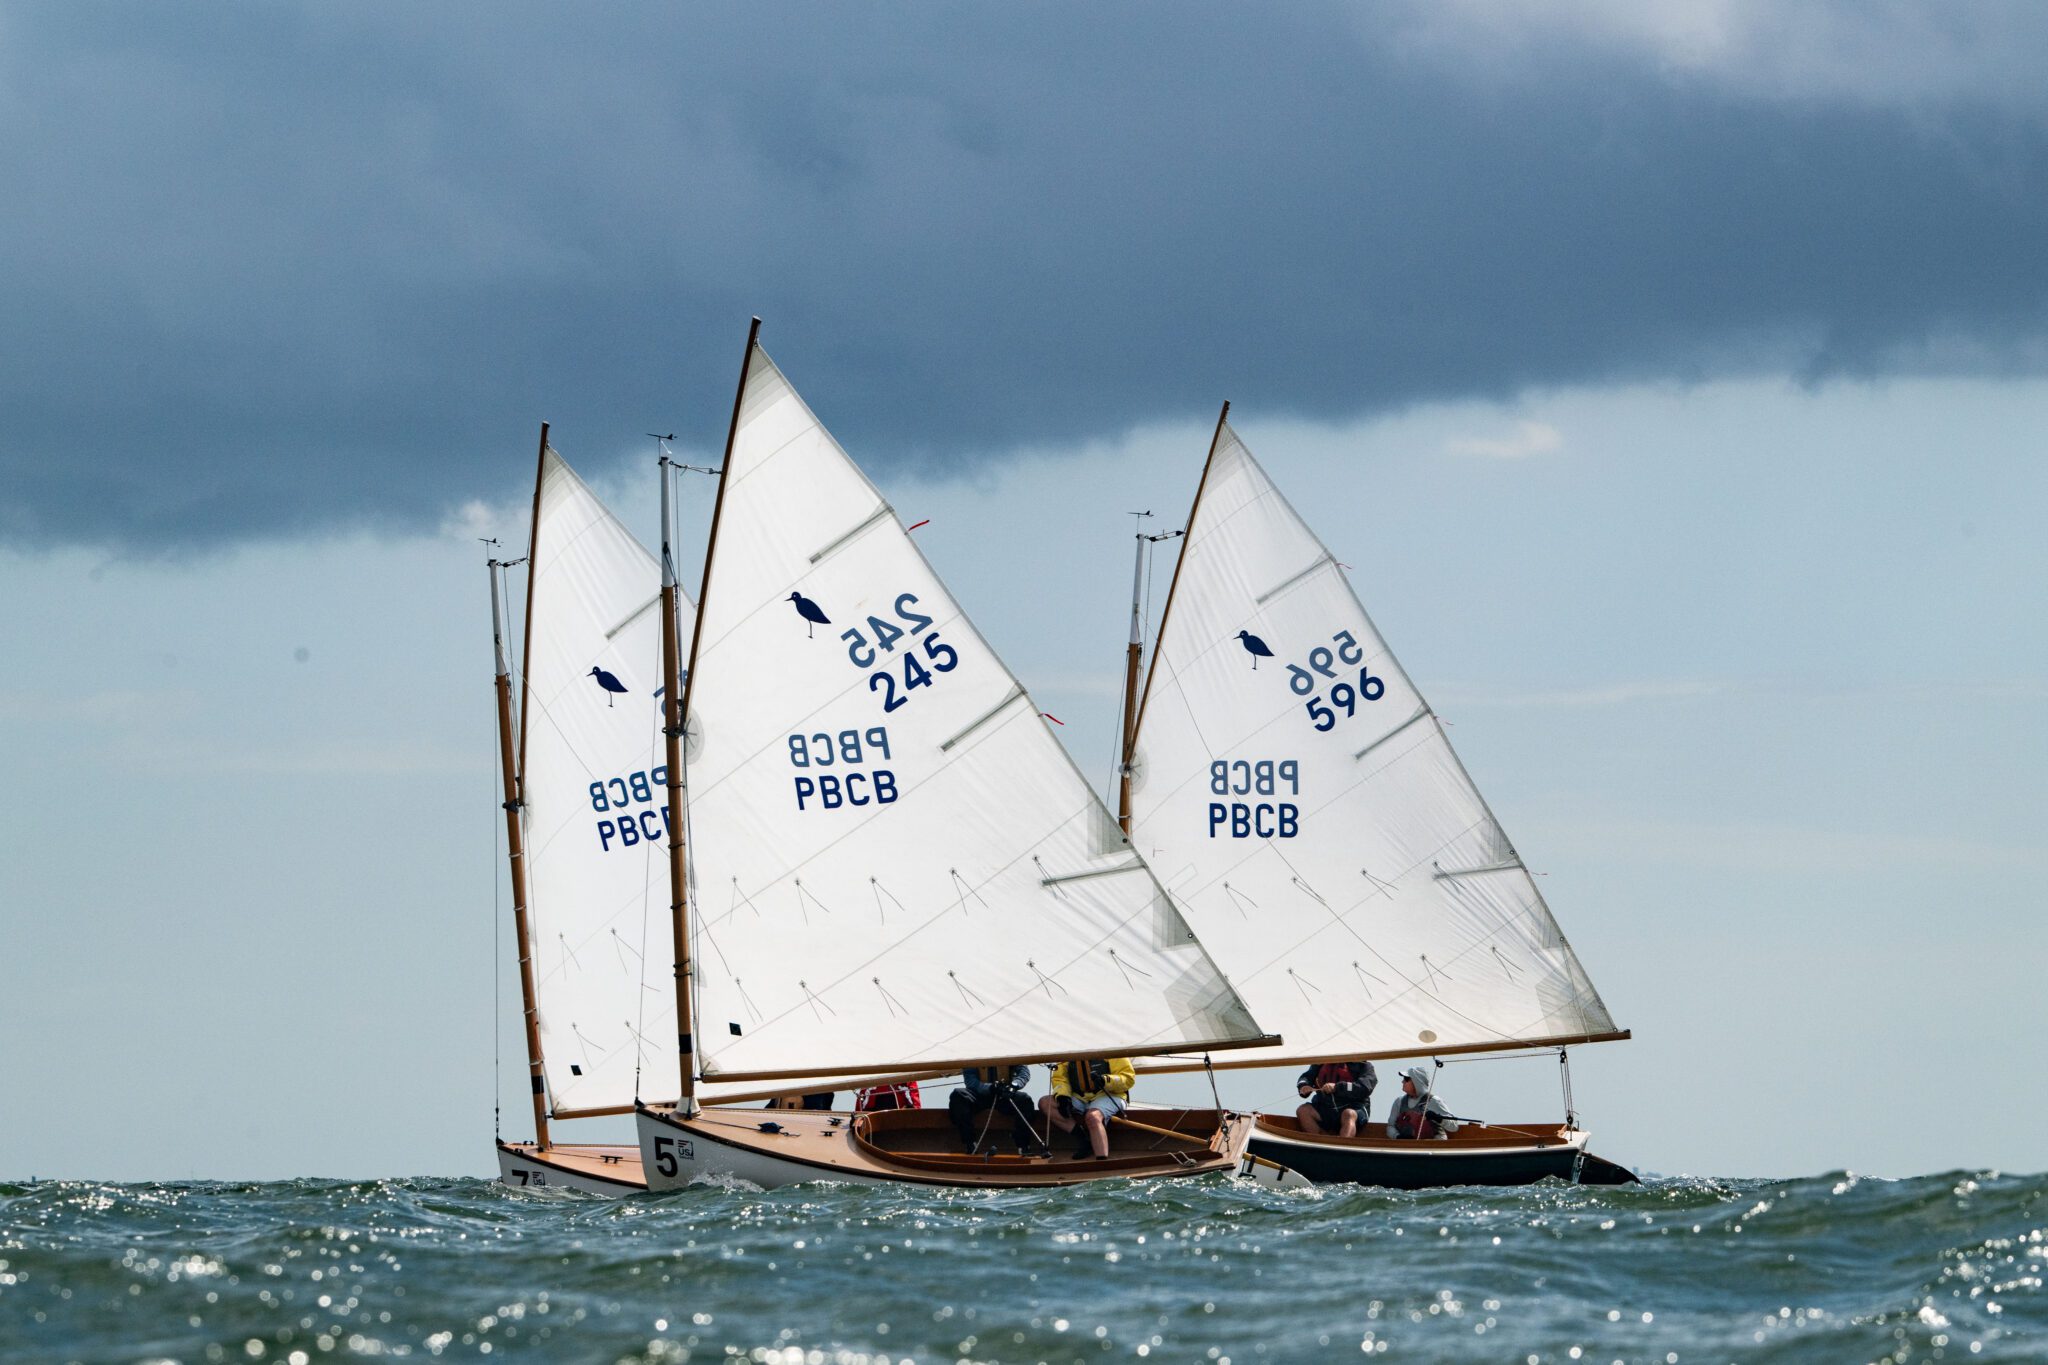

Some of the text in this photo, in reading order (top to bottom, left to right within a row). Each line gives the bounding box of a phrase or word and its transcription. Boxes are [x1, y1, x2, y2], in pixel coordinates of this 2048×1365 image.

[869, 632, 959, 713] 245
[1305, 666, 1385, 732] 596
[794, 769, 899, 811] PBCB
[597, 805, 671, 852] PBC
[1208, 802, 1299, 838] PBCB
[511, 1169, 529, 1186] 7
[654, 1136, 678, 1177] 5
